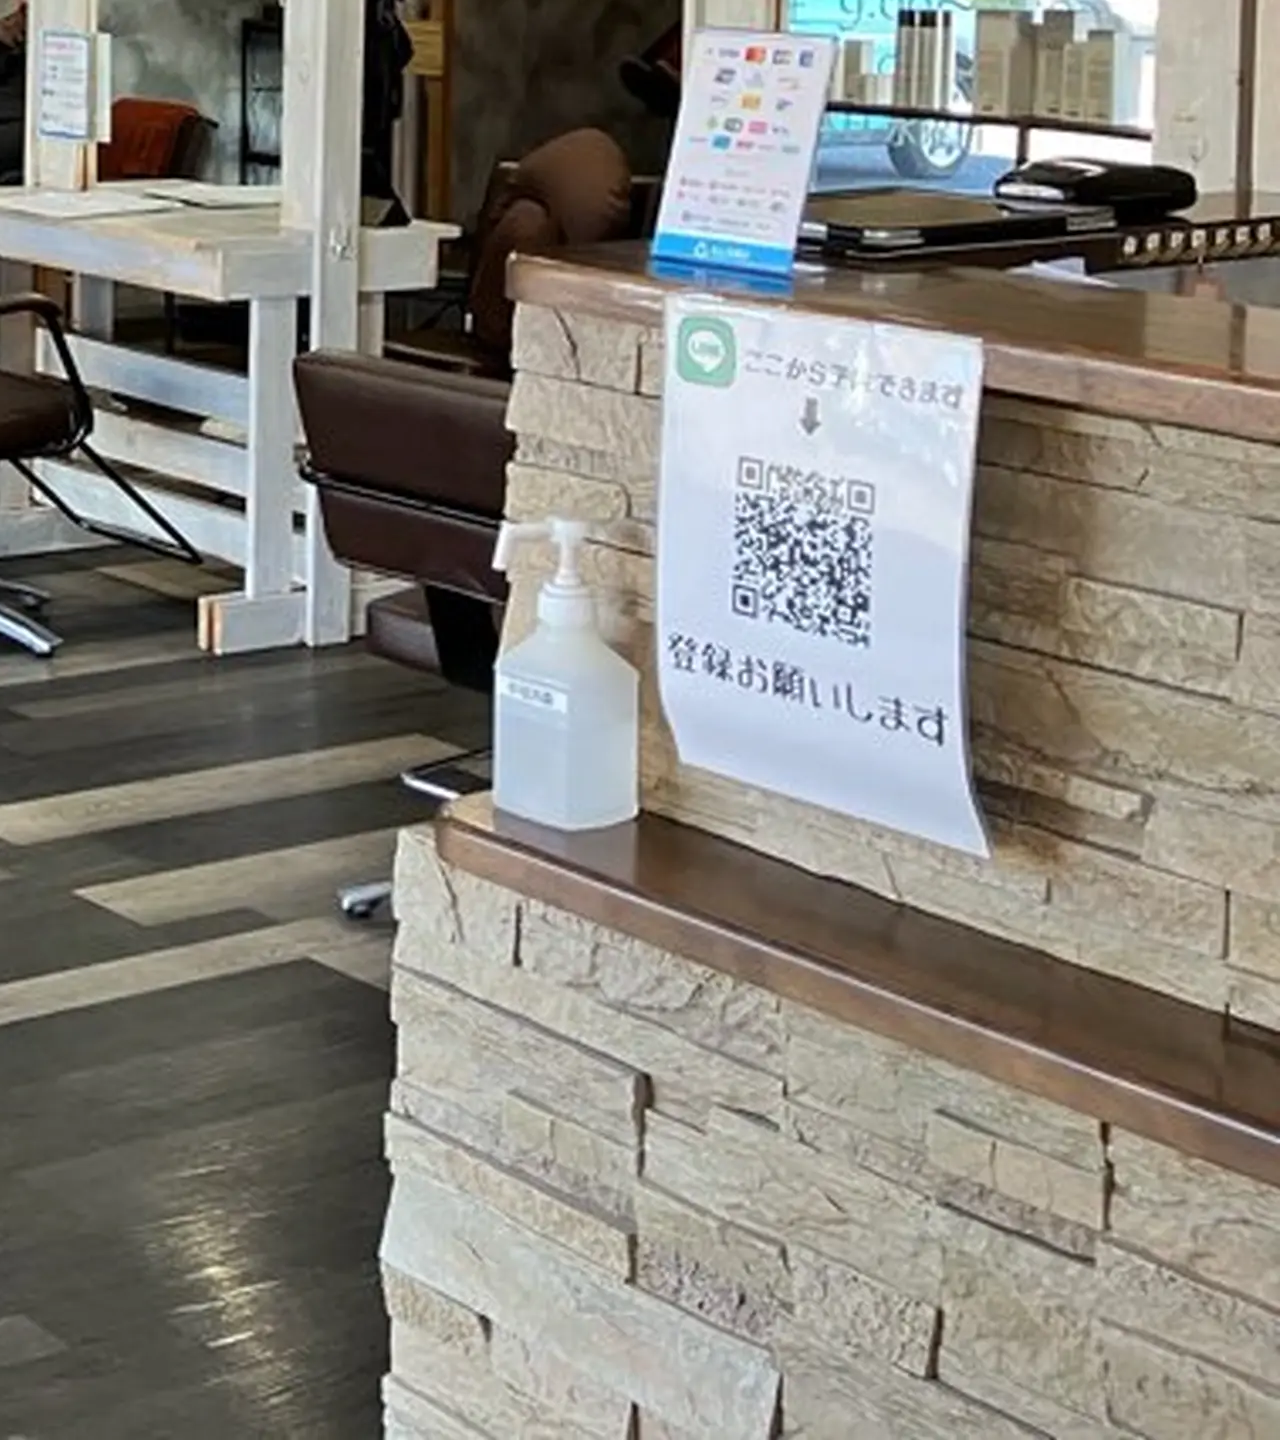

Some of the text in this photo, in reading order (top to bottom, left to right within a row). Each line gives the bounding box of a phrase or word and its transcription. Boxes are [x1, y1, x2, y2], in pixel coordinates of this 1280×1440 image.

[667, 632, 949, 747] 登録お願いします
